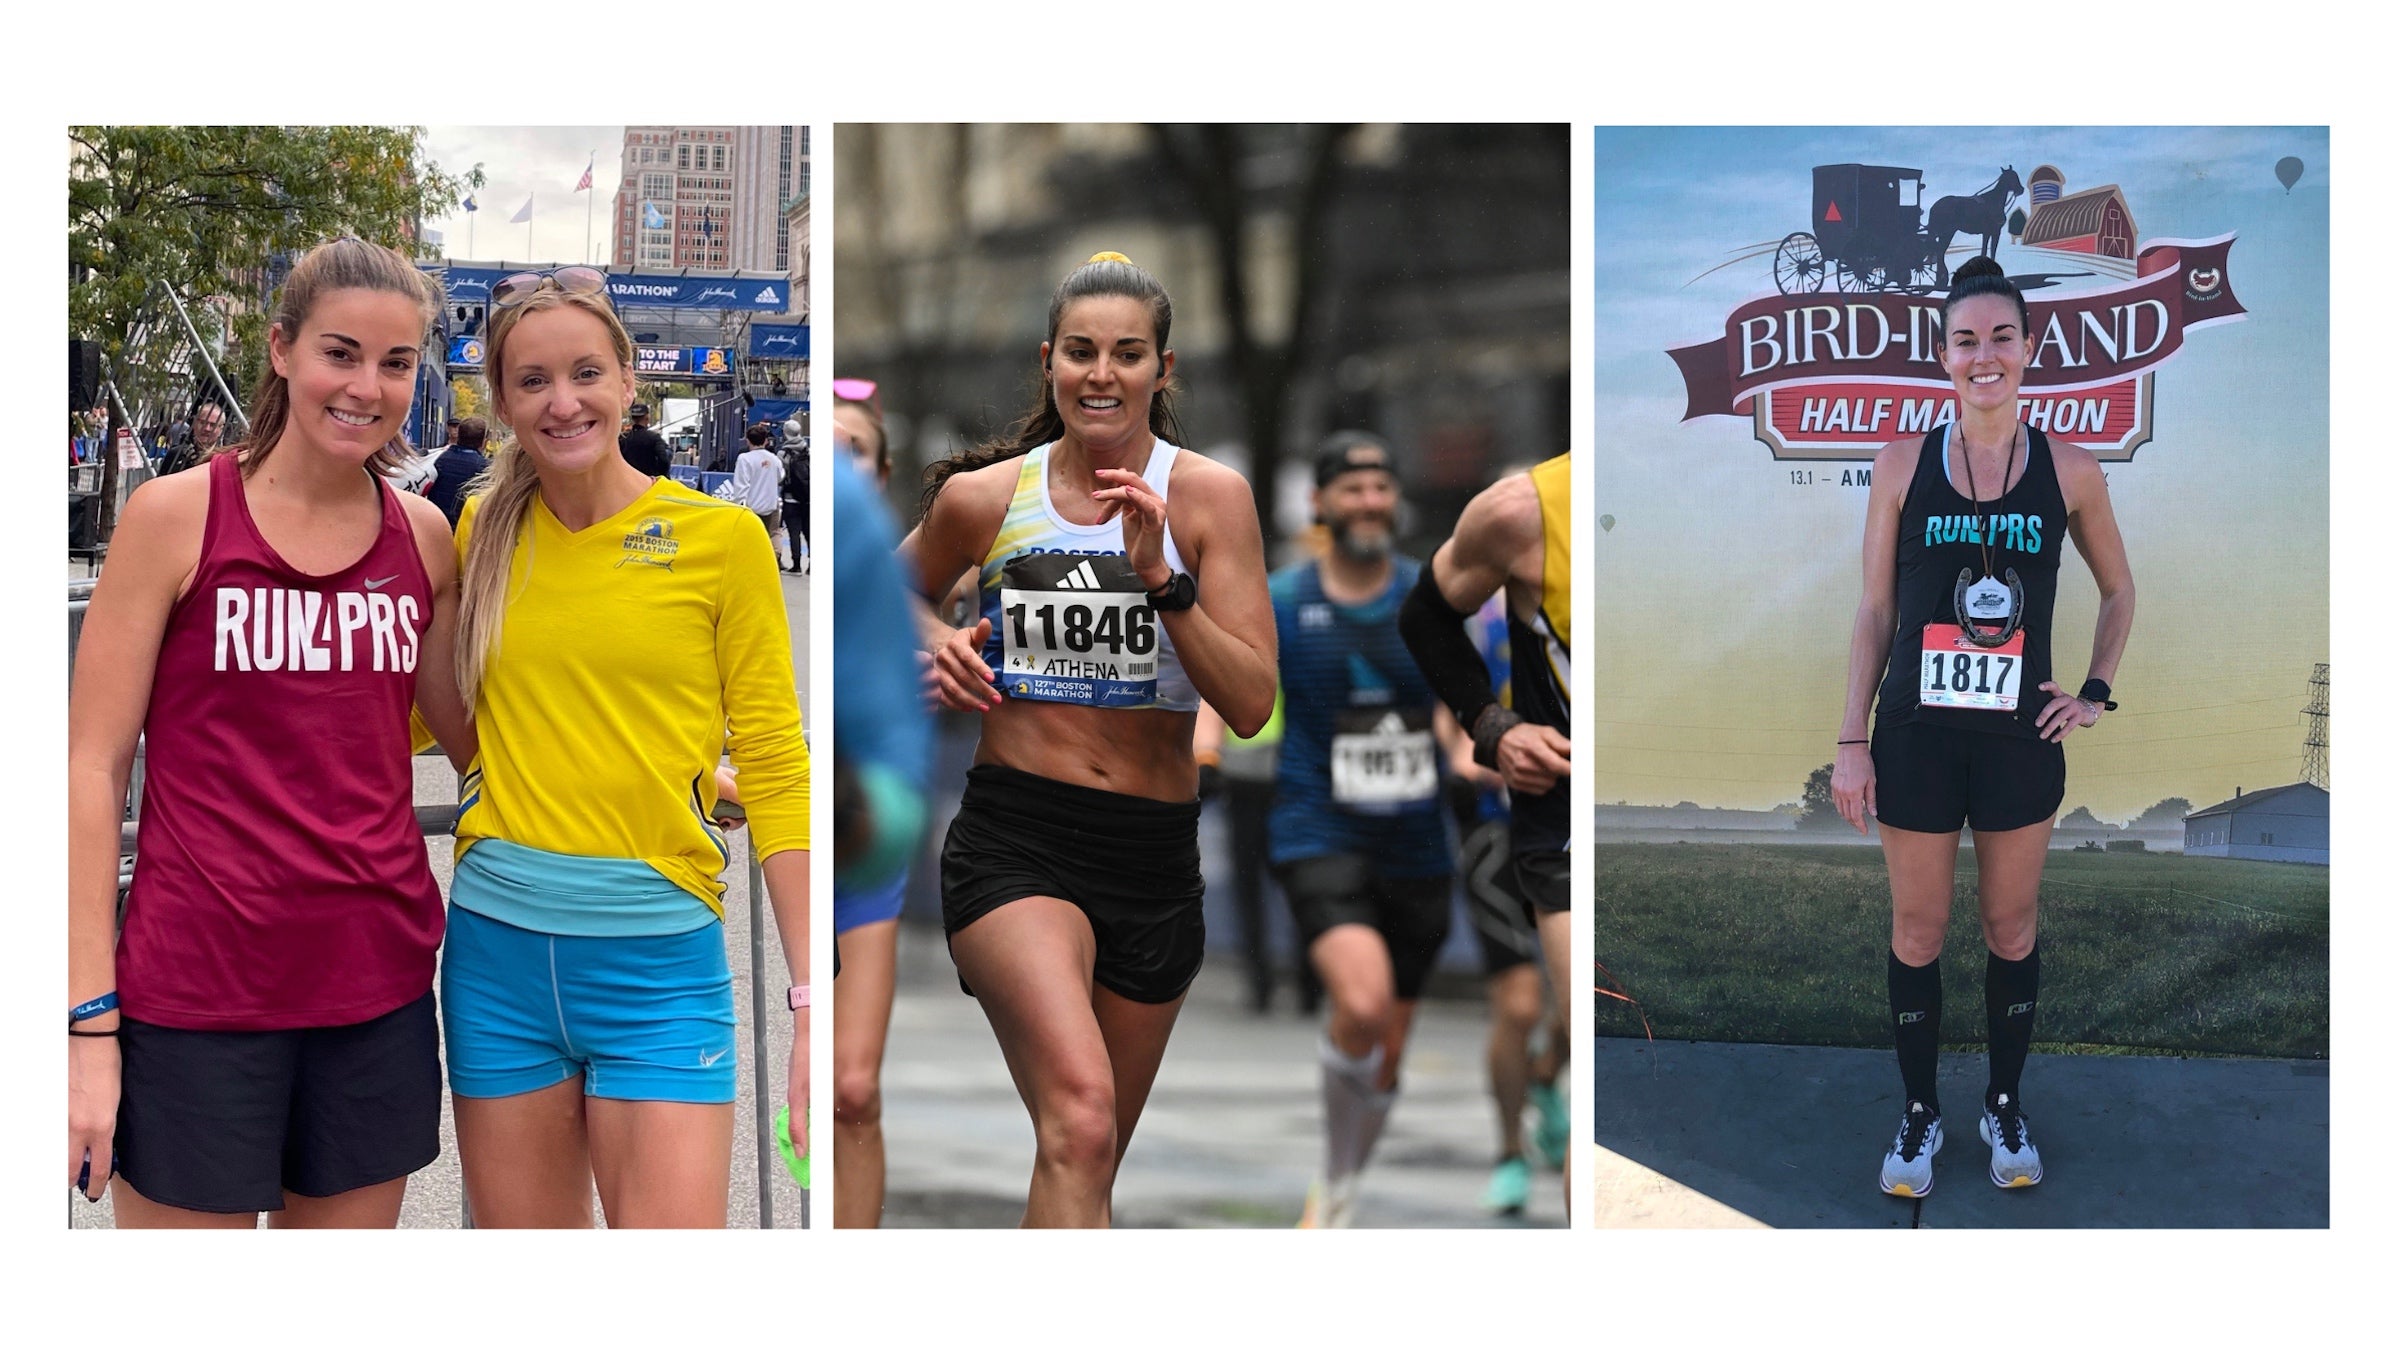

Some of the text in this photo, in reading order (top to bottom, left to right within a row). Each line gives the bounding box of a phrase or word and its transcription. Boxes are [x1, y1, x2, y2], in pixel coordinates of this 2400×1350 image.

[639, 349, 680, 360] TO THE
[639, 360, 676, 370] START
[1800, 398, 1892, 432] HALF
[1790, 470, 1812, 485] 13.1
[625, 534, 679, 548] 2015 BOSTON
[623, 542, 677, 555] MARATHON
[1006, 603, 1155, 655] 11846
[1012, 657, 1021, 667] 4
[1043, 658, 1119, 680] ATHENA
[1931, 652, 2014, 694] 1817
[1056, 682, 1092, 691] BOSTON
[1034, 688, 1092, 699] MARATHON
